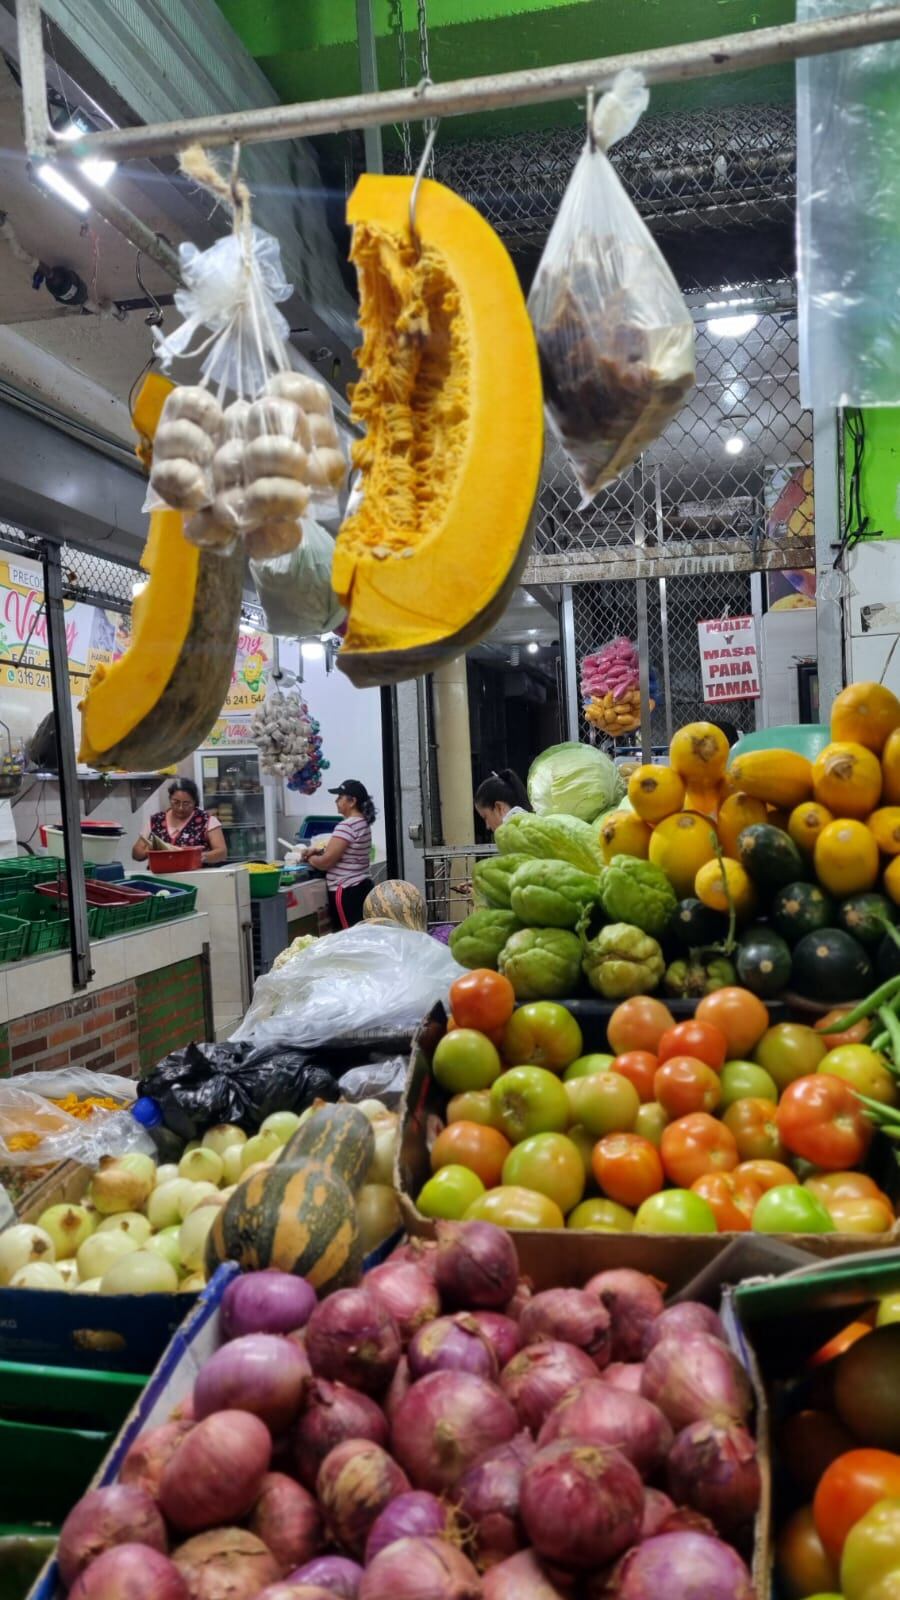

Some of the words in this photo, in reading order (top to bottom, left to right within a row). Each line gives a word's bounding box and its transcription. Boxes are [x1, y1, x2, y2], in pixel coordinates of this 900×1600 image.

[706, 620, 751, 633] MAIZ
[723, 634, 734, 645] Y
[703, 646, 756, 660] MASA
[709, 661, 753, 678] PARA
[704, 679, 760, 697] TAMAL
[233, 695, 248, 705] 241
